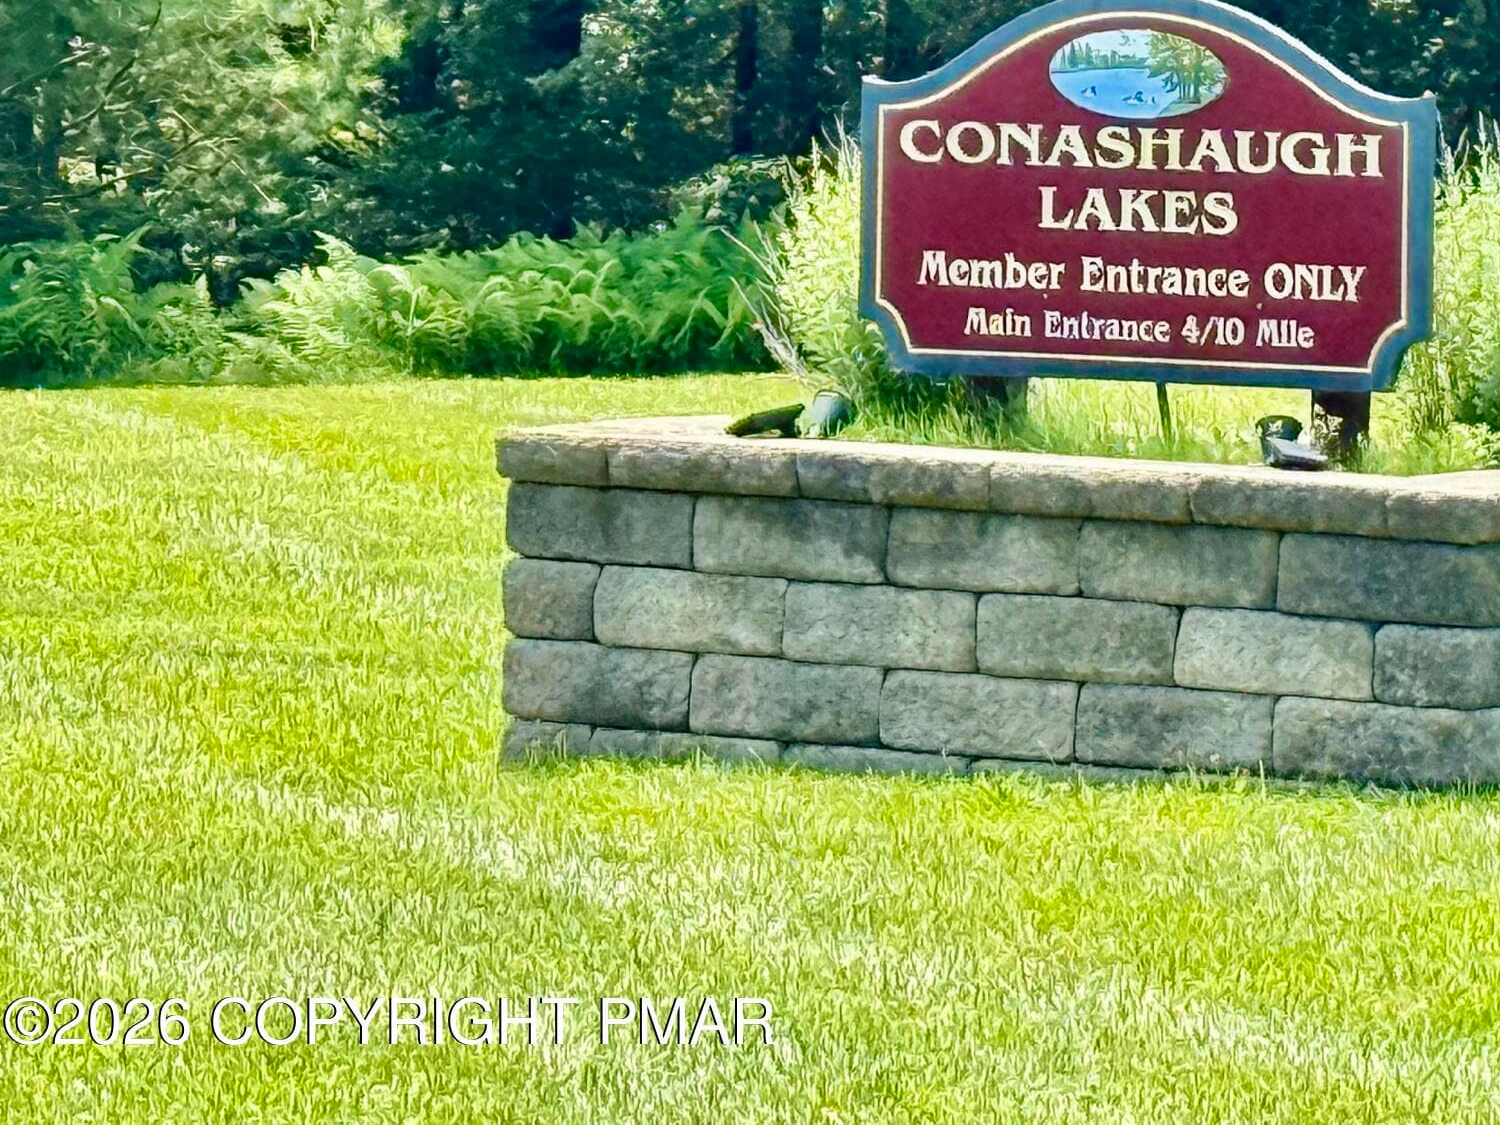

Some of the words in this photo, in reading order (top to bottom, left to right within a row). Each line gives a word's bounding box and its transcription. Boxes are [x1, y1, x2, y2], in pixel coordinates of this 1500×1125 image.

[898, 119, 1384, 178] CONASHAUGH
[1038, 186, 1239, 236] LAKES
[917, 249, 1066, 291] Member
[1080, 256, 1250, 298] Entrance
[1263, 262, 1367, 303] ONLY
[963, 307, 1032, 338] Main
[1043, 311, 1171, 344] Entrance
[1181, 316, 1246, 347] 4/10
[1256, 319, 1315, 349] Mile
